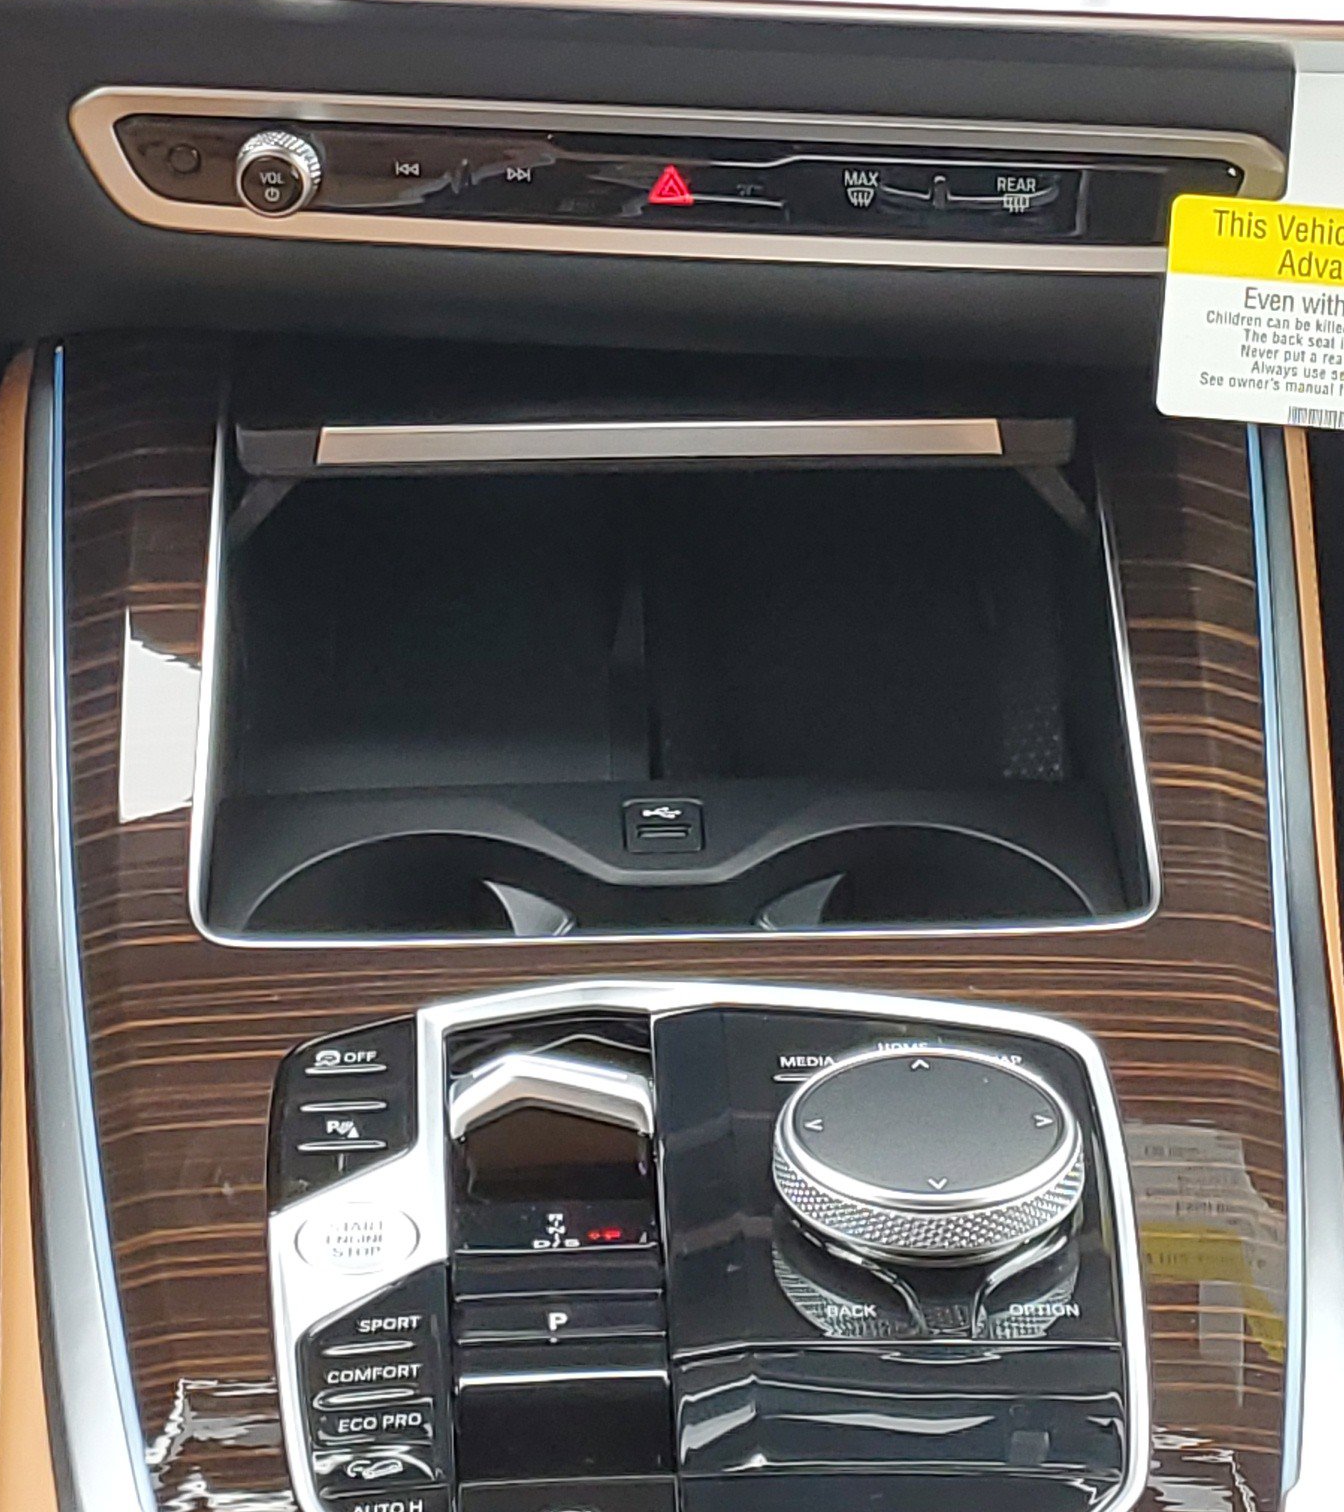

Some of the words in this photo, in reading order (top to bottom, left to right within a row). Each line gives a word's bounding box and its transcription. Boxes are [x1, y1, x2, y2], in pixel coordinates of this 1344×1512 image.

[259, 171, 284, 185] VOL
[844, 170, 880, 187] MAX
[997, 176, 1036, 193] REAR
[1213, 209, 1267, 239] This
[1244, 286, 1294, 312] Even
[1206, 310, 1261, 328] Children
[1267, 317, 1289, 330] can
[1295, 318, 1310, 332] be
[1243, 328, 1267, 343] The
[1272, 331, 1304, 346] back
[1241, 345, 1279, 360] Never
[1284, 350, 1305, 364] put
[1310, 353, 1317, 363] a
[1251, 360, 1298, 379] Always
[1303, 367, 1326, 380] use
[1199, 371, 1224, 386] See
[1285, 380, 1334, 396] manual
[344, 1050, 377, 1063] OFF
[780, 1056, 835, 1068] MEDIA
[826, 1304, 877, 1318] BACK
[1008, 1304, 1081, 1318] OPTION
[358, 1315, 422, 1332] SPORT
[548, 1312, 568, 1331] P
[327, 1363, 423, 1384] COMFORT
[338, 1416, 377, 1433] ECO
[383, 1412, 422, 1430] PRO
